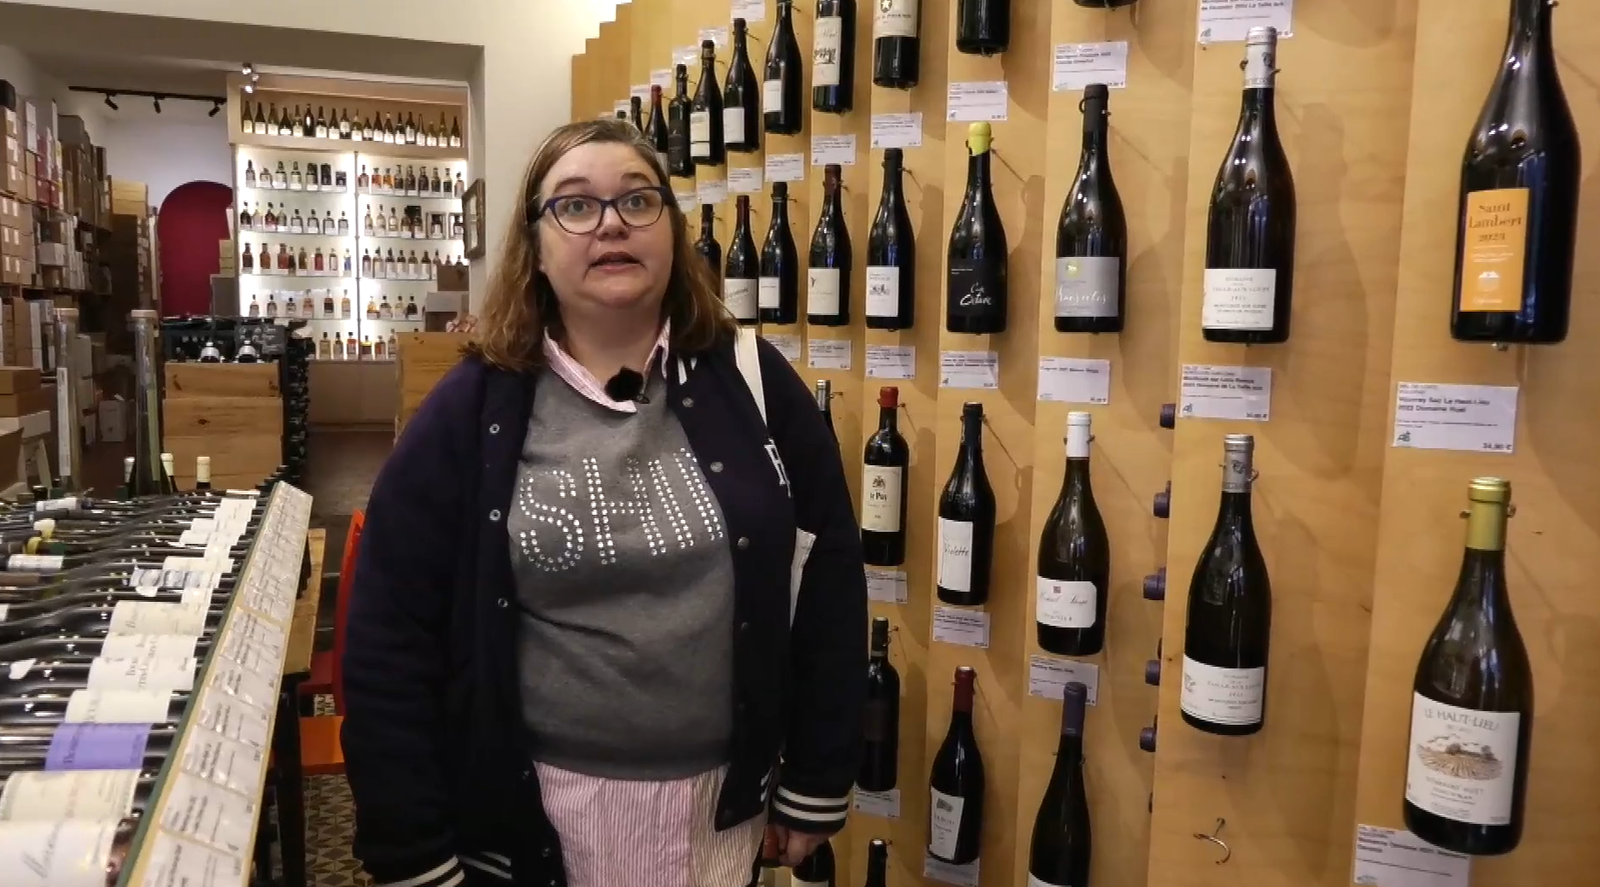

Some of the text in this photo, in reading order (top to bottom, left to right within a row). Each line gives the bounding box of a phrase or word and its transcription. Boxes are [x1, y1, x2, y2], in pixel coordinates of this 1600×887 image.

[1478, 202, 1512, 213] Saint
[1468, 214, 1523, 230] Lambert
[1424, 707, 1433, 720] LE
[1436, 710, 1500, 732] HAUT-LIEU
